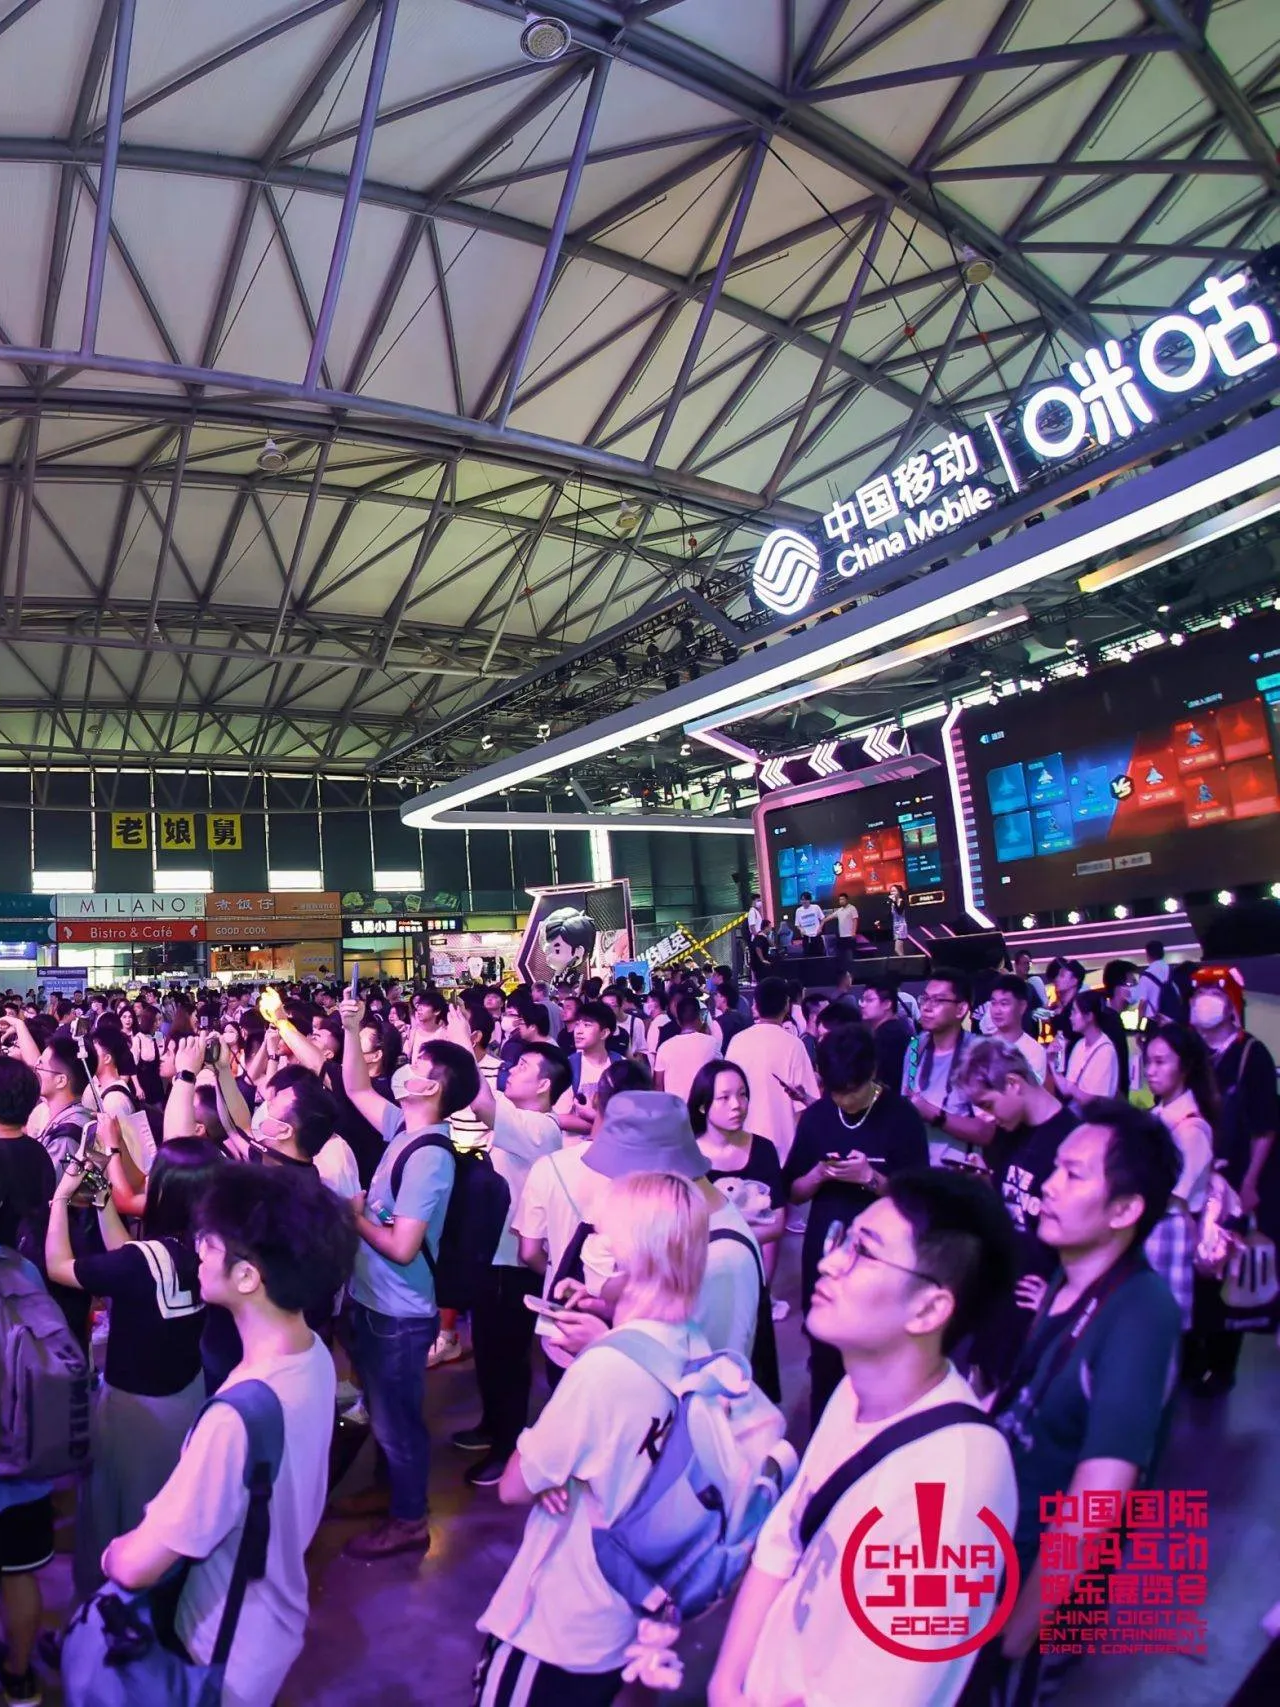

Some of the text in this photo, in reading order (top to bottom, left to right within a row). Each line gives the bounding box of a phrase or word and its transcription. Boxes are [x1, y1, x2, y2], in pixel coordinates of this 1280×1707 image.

[1023, 275, 1279, 457] 咪咕
[824, 432, 978, 544] 中国移动
[836, 484, 992, 577] China Mobile
[116, 816, 237, 846] 老娘舅
[80, 898, 185, 912] MILANO
[90, 926, 172, 938] Bistro & Café
[215, 927, 266, 935] GOOD COOK
